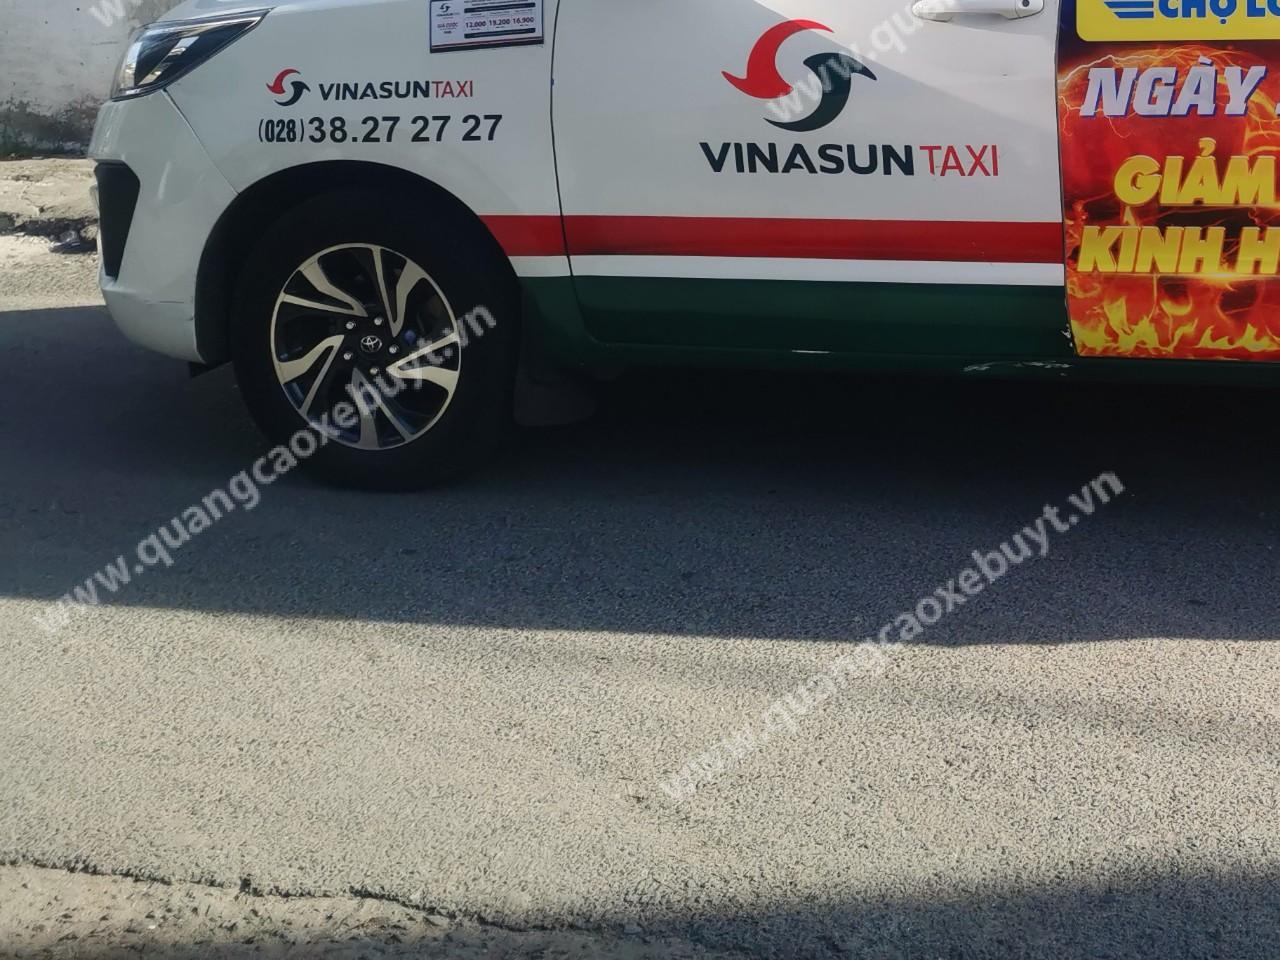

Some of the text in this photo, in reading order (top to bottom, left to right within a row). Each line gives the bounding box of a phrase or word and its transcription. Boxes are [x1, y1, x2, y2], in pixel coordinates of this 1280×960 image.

[1079, 54, 1268, 117] NGÀY
[411, 115, 451, 142] 27
[461, 114, 503, 142] 27
[1113, 137, 1277, 207] GIẢM
